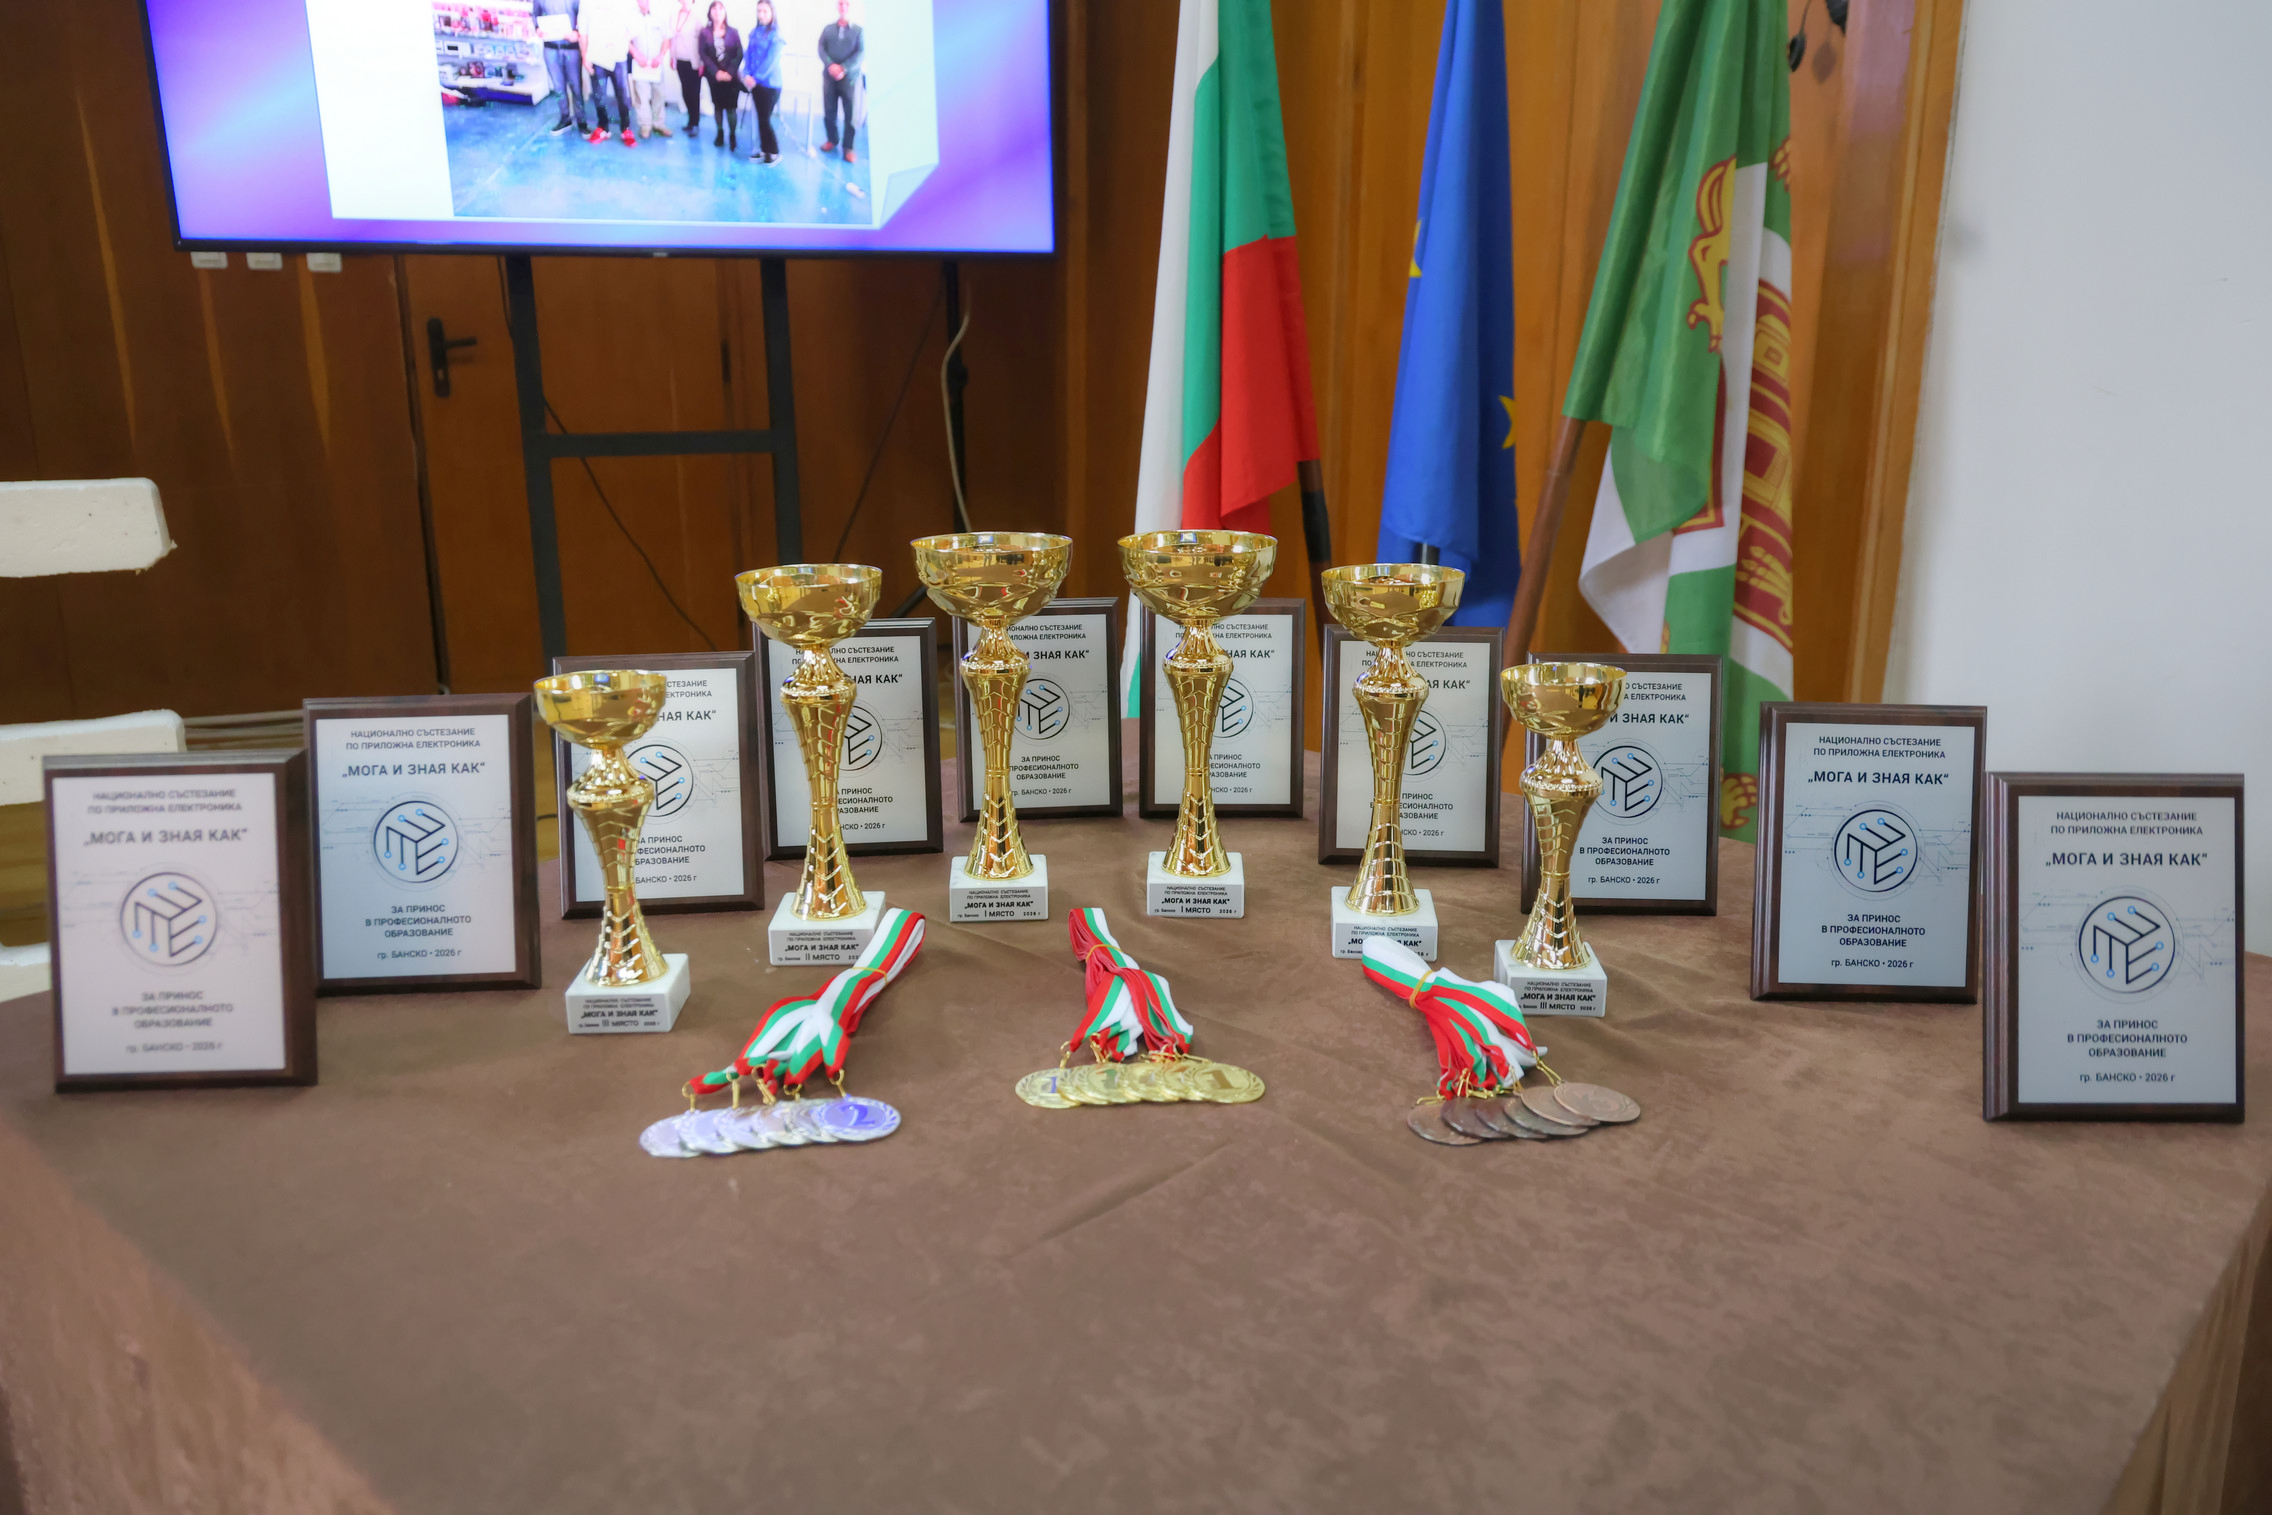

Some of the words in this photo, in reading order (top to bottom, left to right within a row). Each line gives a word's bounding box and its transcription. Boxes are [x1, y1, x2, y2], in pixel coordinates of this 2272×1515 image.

[848, 646, 894, 654] СЪСТЕЗАНИЕ
[1034, 651, 1061, 659] ЗНАЯ
[667, 680, 707, 688] СТЕЗАНИЕ
[666, 690, 712, 698] ЕКТРОНИКА
[659, 711, 682, 721] НАЯ
[1610, 714, 1618, 723] И
[1623, 713, 1655, 723] ЗНАЯ
[351, 729, 414, 739] НАЦИОНАЛНО
[416, 728, 475, 736] СЪСТЕЗАНИЕ
[346, 742, 359, 750] ПО
[361, 741, 414, 749] ПРИЛОЖНА
[416, 740, 480, 748] ЕЛЕКТРОНИКА
[1819, 736, 1881, 745] НАЦИОНАЛНО
[1883, 737, 1941, 746] СЪСТЕЗАНИЕ
[1828, 748, 1880, 756] ПРИЛОЖНА
[1882, 750, 1945, 758] ЕЛЕКТРОНИКА
[393, 764, 402, 775] И
[408, 763, 446, 775] ЗНАЯ
[1858, 772, 1867, 783] И
[1872, 772, 1910, 784] ЗНАЯ
[93, 790, 166, 801] НАЦИОНАЛНО
[167, 789, 235, 799] СЪСТЕЗАНИЕ
[167, 803, 242, 813] ЕЛЕКТРОНИКА
[2057, 812, 2128, 822] НАЦИОНАЛНО
[2131, 812, 2196, 821] СЪСТЕЗАНИЕ
[2051, 825, 2065, 834] ПО
[2068, 826, 2127, 834] ПРИЛОЖНА
[2130, 826, 2203, 835] ЕЛЕКТРОНИКА
[141, 831, 152, 843] И
[159, 829, 203, 843] ЗНАЯ
[648, 835, 682, 843] ПРИНОС
[1615, 837, 1648, 845] ПРИНОС
[637, 845, 705, 855] ФЕСИОНАЛНОТО
[1587, 847, 1670, 855] ПРОФЕСИОНАЛНОТО
[635, 856, 689, 865] БРАЗОВАНИЕ
[1595, 858, 1654, 866] ОБРАЗОВАНИЕ
[2103, 853, 2113, 865] И
[2120, 853, 2163, 865] ЗНАЯ
[674, 874, 692, 882] 2026
[391, 906, 404, 914] ЗА
[406, 905, 445, 913] ПРИНОС
[374, 915, 471, 926] ПРОФЕСИОНАЛНОТО
[1848, 914, 1860, 922] ЗА
[1862, 914, 1900, 923] ПРИНОС
[384, 928, 453, 938] ОБРАЗОВАНИЕ
[1822, 925, 1827, 933] В
[1830, 925, 1925, 935] ПРОФЕСИОНАЛНОТО
[1839, 938, 1906, 947] ОБРАЗОВАНИЕ
[377, 952, 388, 960] гр.
[391, 949, 427, 958] БАНСКО
[435, 949, 456, 957] 2026
[1831, 960, 1842, 968] гр.
[1845, 959, 1880, 967] БАНСКО
[1888, 960, 1908, 968] 2026
[142, 993, 156, 1002] ЗА
[158, 991, 203, 1000] ПРИНОС
[2097, 1020, 2111, 1029] ЗА
[2114, 1020, 2158, 1029] ПРИНОС
[2067, 1034, 2074, 1043] В
[2077, 1034, 2187, 1043] ПРОФЕСИОНАЛНОТО
[2089, 1048, 2166, 1057] ОБРАЗОВАНИЕ
[2080, 1074, 2091, 1083] гр.
[2096, 1073, 2136, 1082] БАНСКО
[2145, 1073, 2168, 1082] 2026
[844, 1105, 876, 1127] 2
